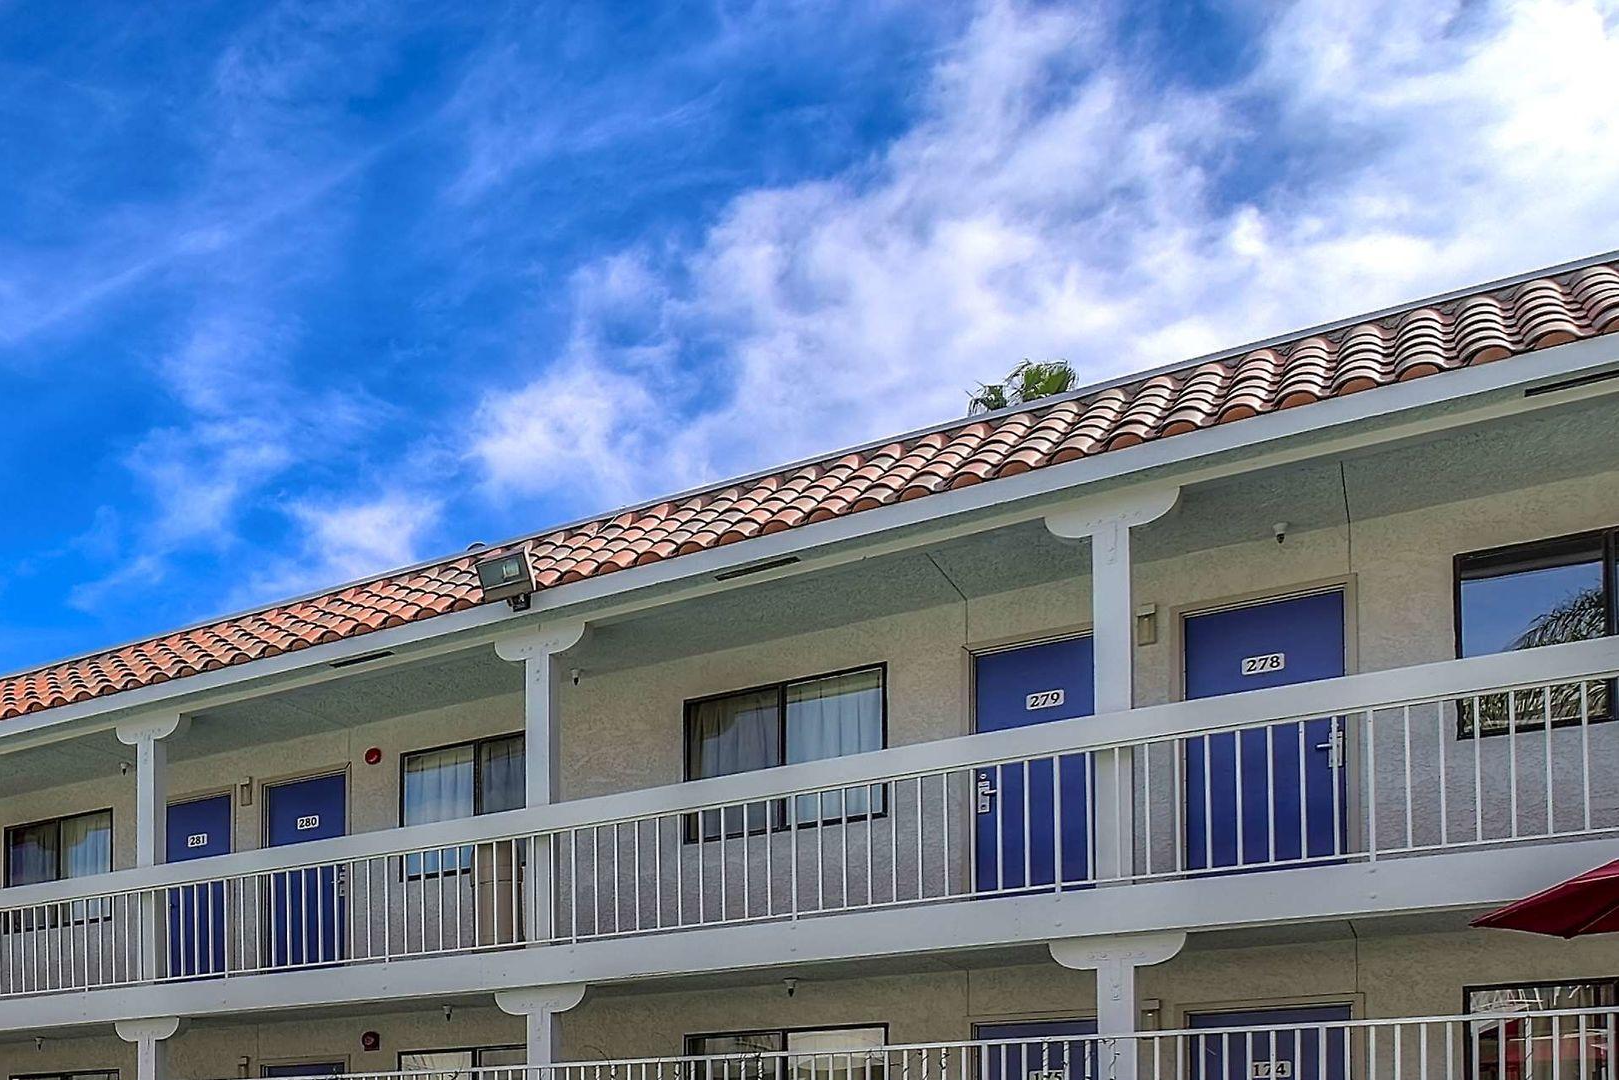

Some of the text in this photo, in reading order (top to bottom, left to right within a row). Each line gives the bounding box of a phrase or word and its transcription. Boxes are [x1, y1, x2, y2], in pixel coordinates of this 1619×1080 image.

[1245, 655, 1281, 672] 278
[1030, 691, 1061, 707] 279
[298, 816, 318, 828] 280
[189, 835, 206, 846] 281
